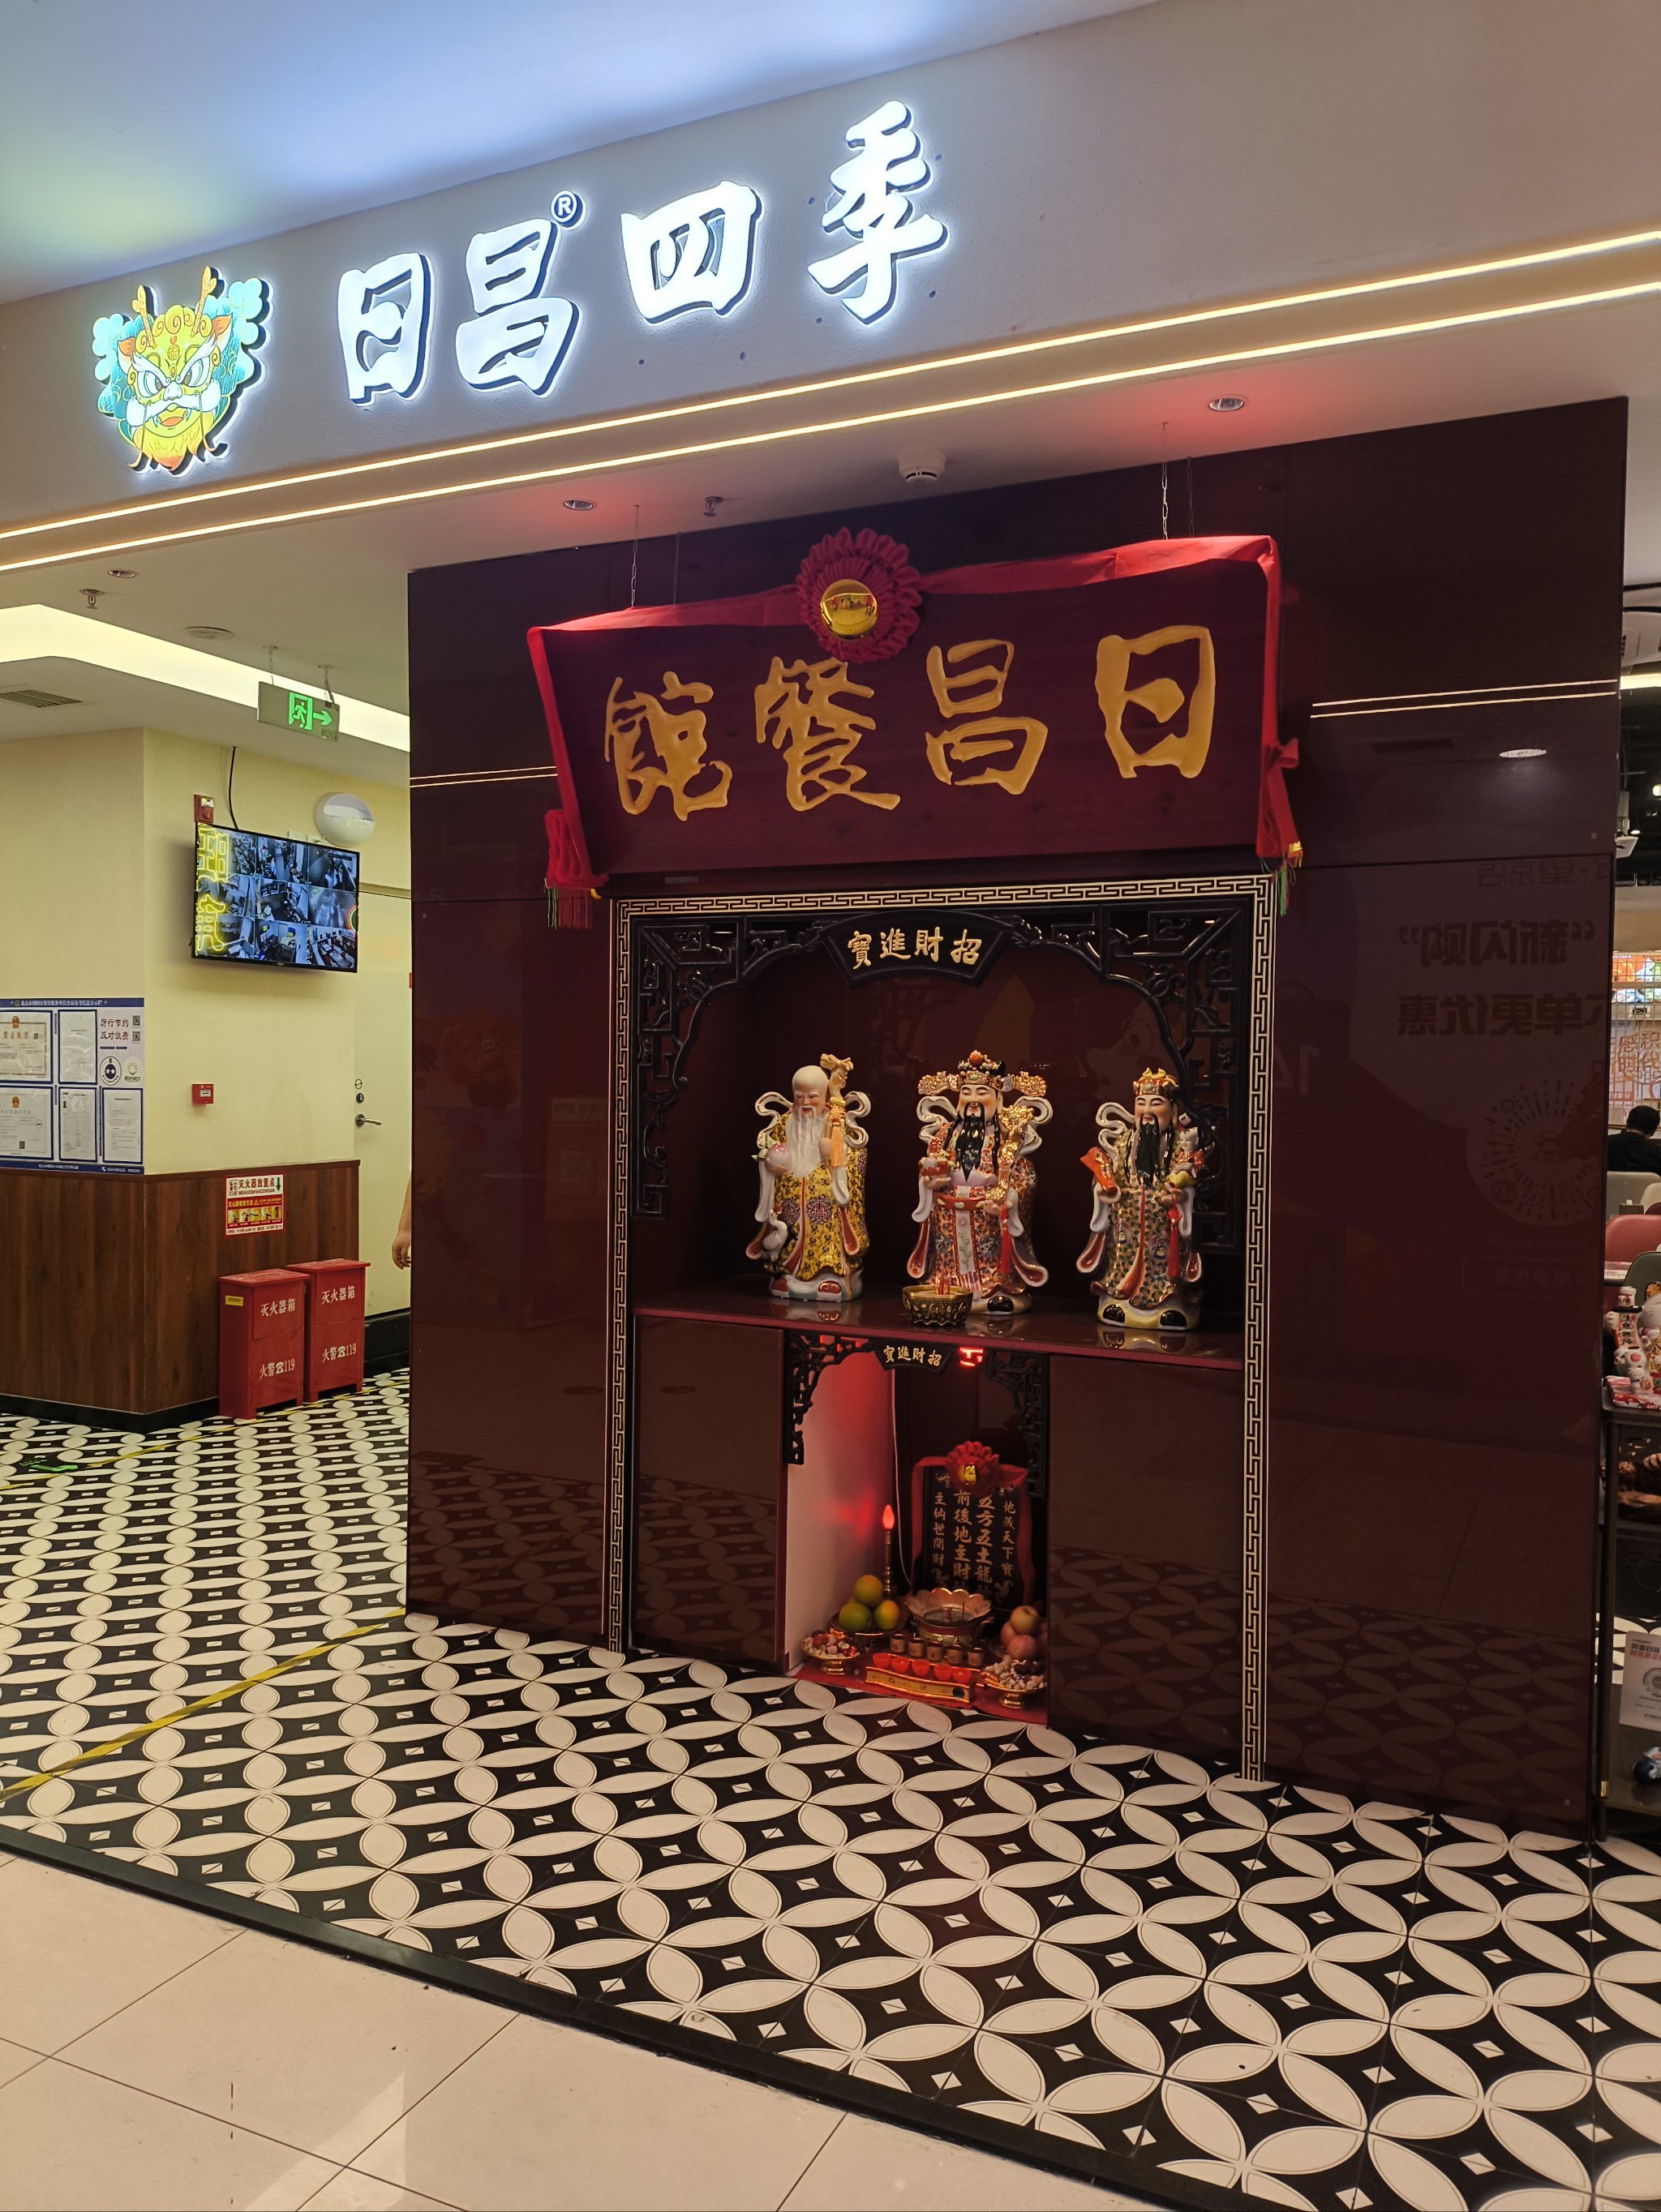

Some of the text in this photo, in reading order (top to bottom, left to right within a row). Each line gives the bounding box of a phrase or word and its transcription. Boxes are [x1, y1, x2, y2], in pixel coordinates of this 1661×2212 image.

[337, 100, 947, 405] 日昌四季
[100, 1018, 129, 1027] 厉行节约
[100, 1031, 129, 1040] 反对浪费
[321, 1285, 356, 1305] 灭火器箱
[260, 1297, 296, 1317] 灭火器箱
